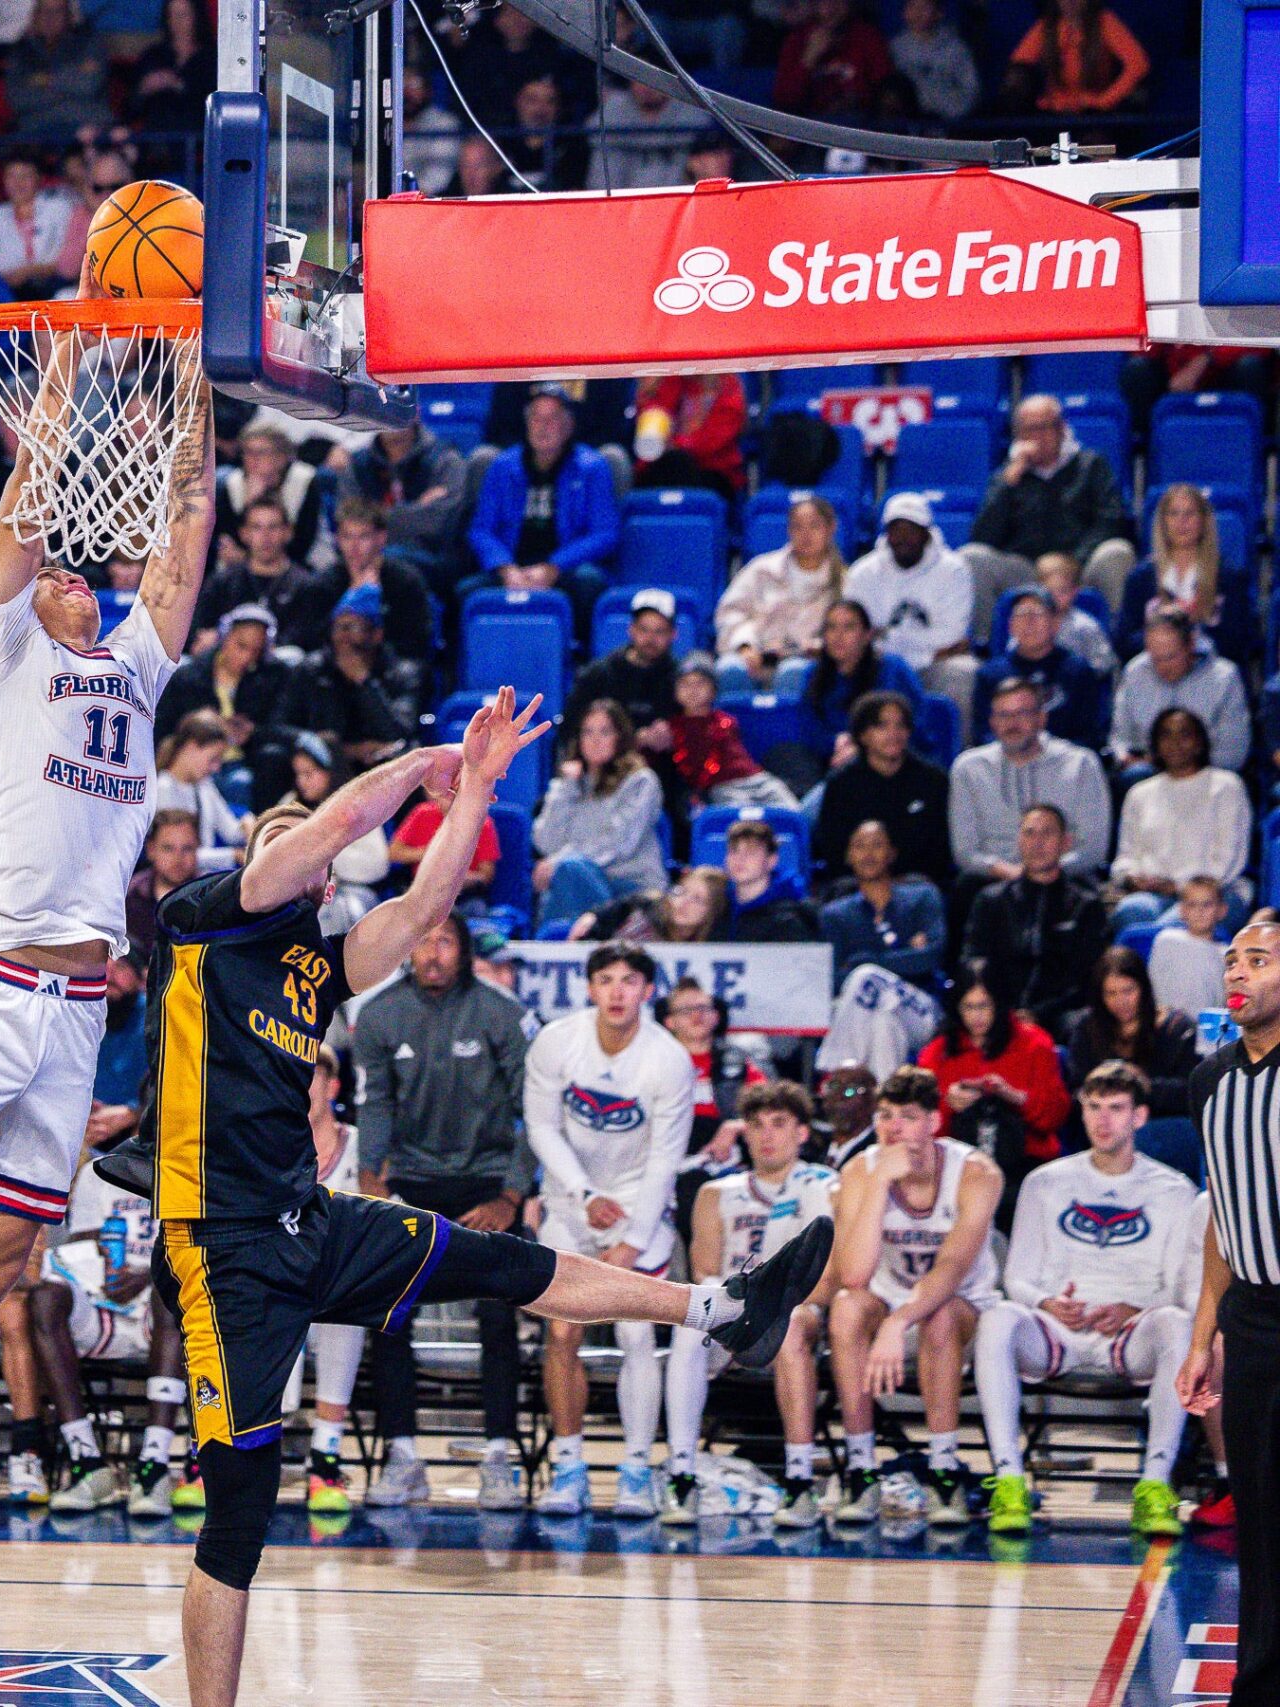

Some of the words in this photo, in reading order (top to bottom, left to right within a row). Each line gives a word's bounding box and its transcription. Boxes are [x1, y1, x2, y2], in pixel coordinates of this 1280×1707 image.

[84, 706, 131, 767] 11
[47, 757, 145, 802] ATLANTIC
[281, 944, 331, 989] EAST
[283, 972, 317, 1025] 43
[248, 1009, 320, 1064] CAROLIN
